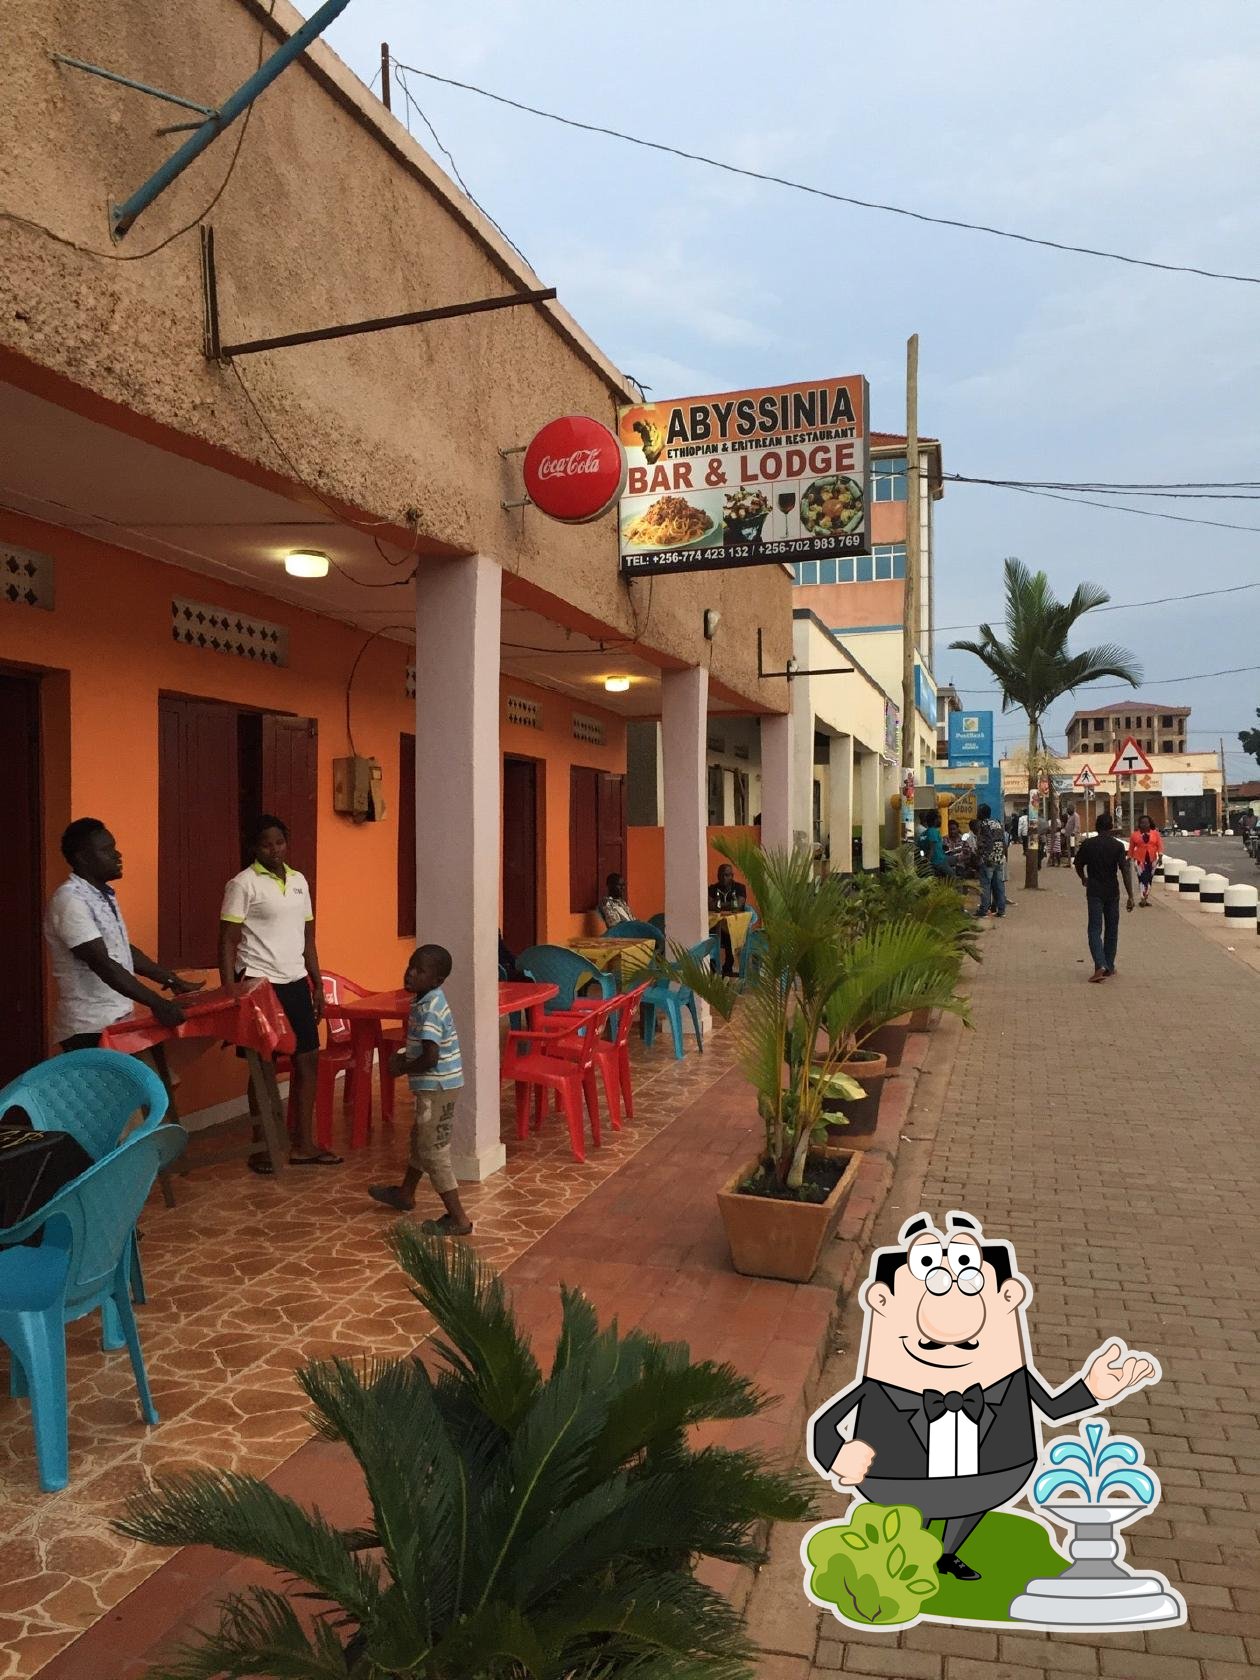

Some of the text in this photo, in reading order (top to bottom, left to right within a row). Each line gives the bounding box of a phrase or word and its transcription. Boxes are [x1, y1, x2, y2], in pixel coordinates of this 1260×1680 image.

[666, 386, 856, 444] ABYSSINIA
[667, 426, 855, 459] ETHIOPIAN & ERITREAN RESTAURANT
[537, 448, 601, 480] Coca-Cola
[628, 442, 855, 494] BAR & LODGE
[626, 555, 650, 567] TEL:
[652, 552, 702, 565] +256-774
[704, 548, 725, 559] 423
[728, 546, 749, 557] 132
[758, 539, 810, 555] +256-702
[814, 537, 835, 549] 983
[838, 534, 860, 547] 769
